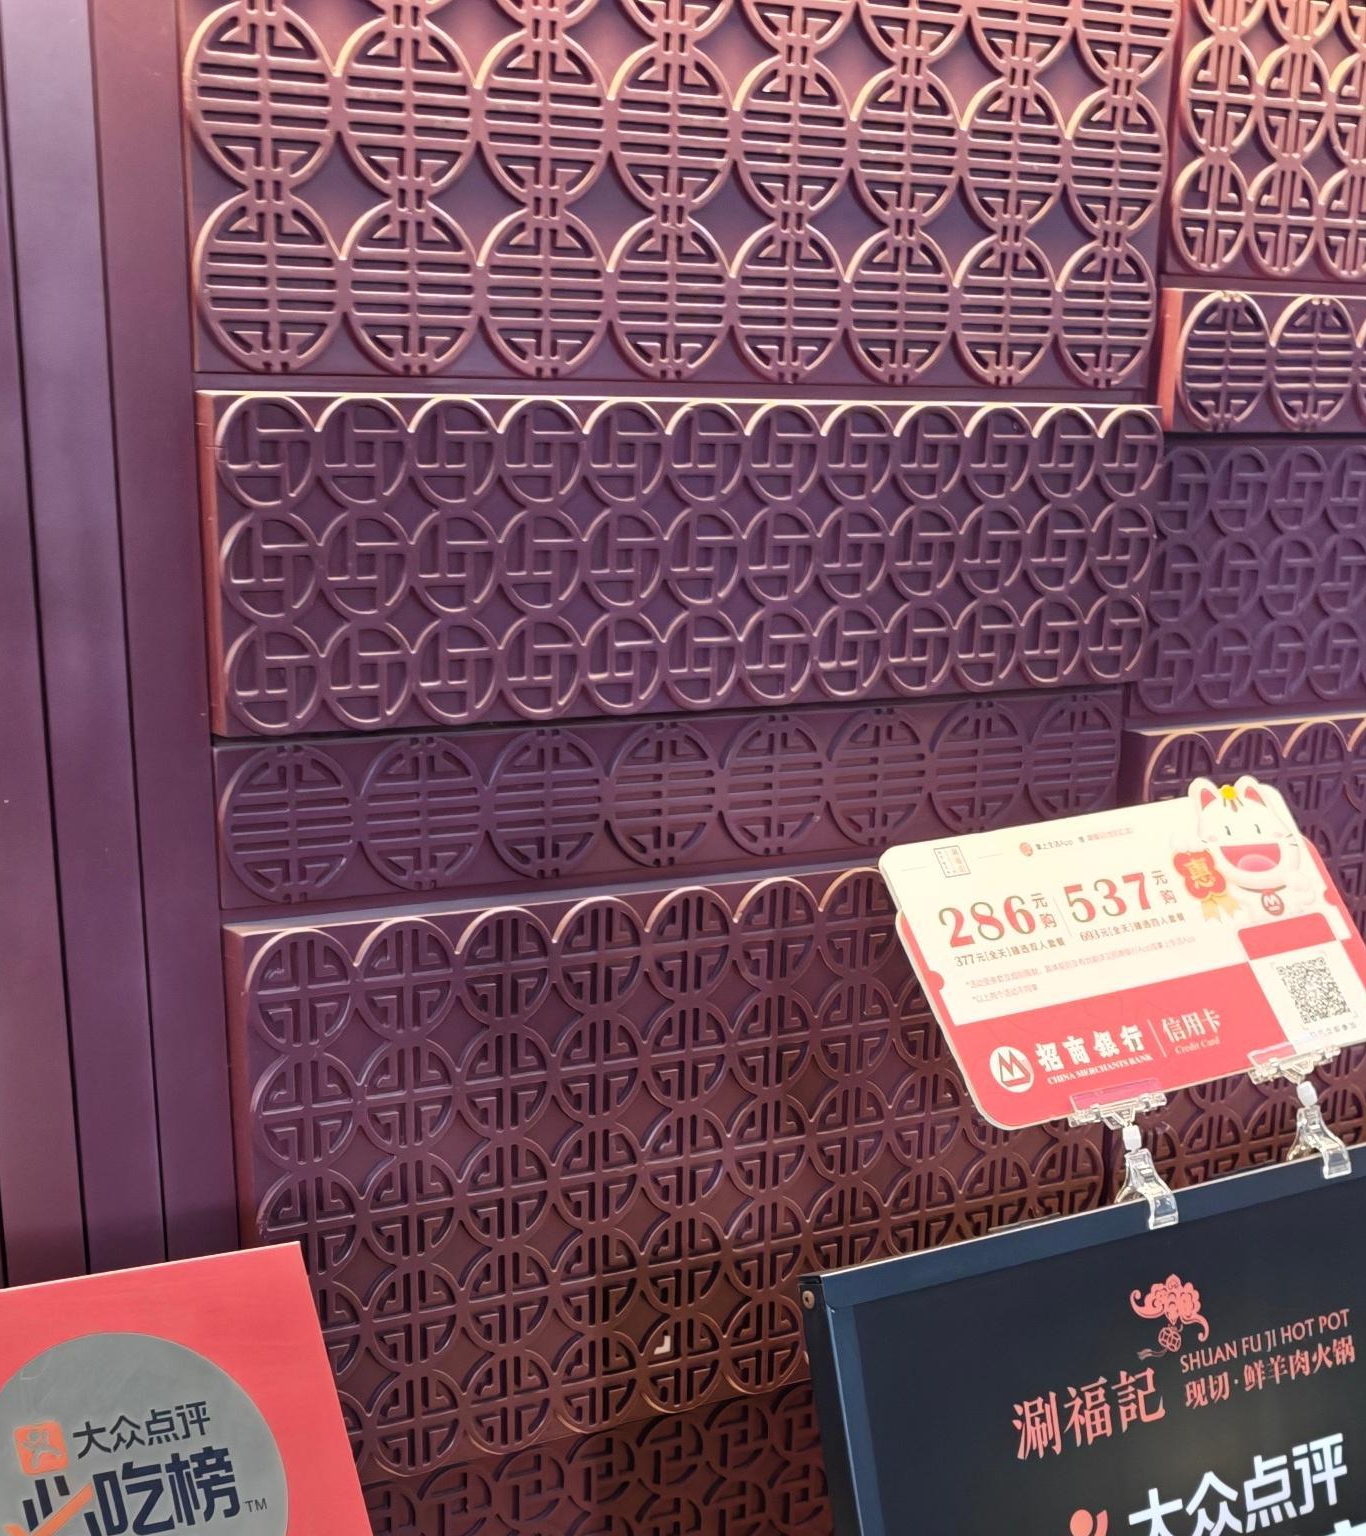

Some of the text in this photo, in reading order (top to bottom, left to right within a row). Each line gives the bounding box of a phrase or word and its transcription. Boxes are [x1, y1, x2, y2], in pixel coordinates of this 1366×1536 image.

[938, 894, 1036, 948] 286
[1063, 871, 1151, 923] 537
[1035, 1008, 1220, 1077] 招商银行 信用卡
[1180, 1309, 1350, 1373] SHUAN FU JI HOT POT
[1012, 1335, 1355, 1460] 涮福記 现切·鲜羊肉火锅
[73, 1401, 212, 1457] 大众点评
